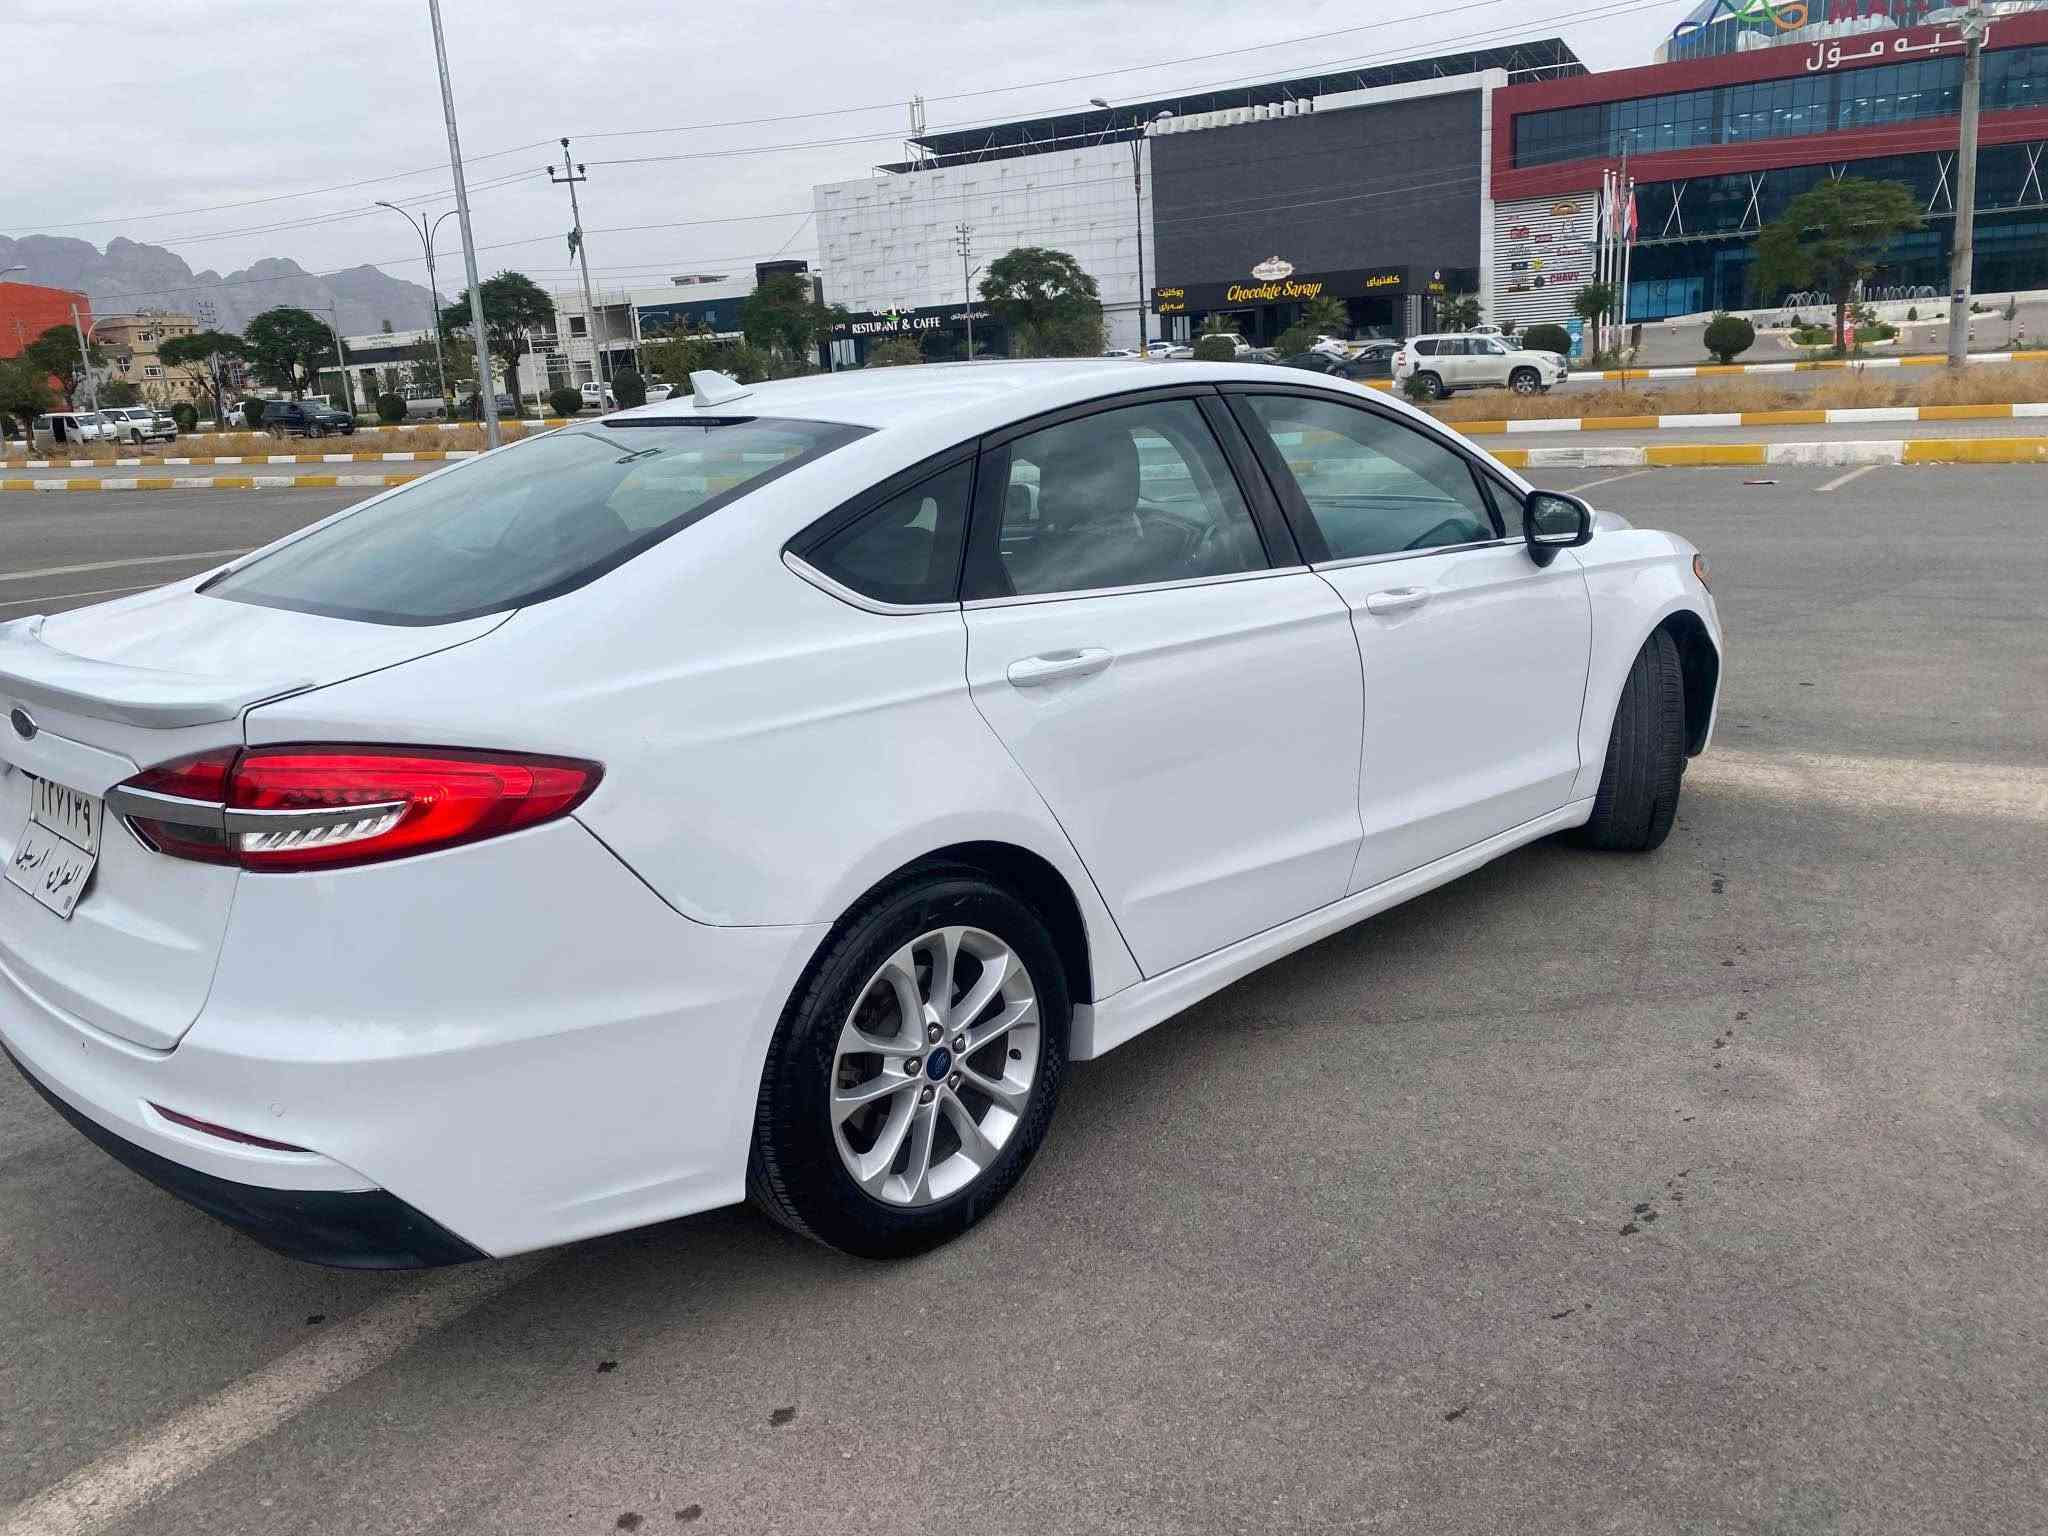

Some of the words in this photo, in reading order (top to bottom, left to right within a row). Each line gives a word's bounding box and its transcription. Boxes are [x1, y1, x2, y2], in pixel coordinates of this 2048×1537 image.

[1227, 282, 1281, 302] Chocolate
[902, 318, 911, 330] &
[914, 317, 941, 328] CAFFE
